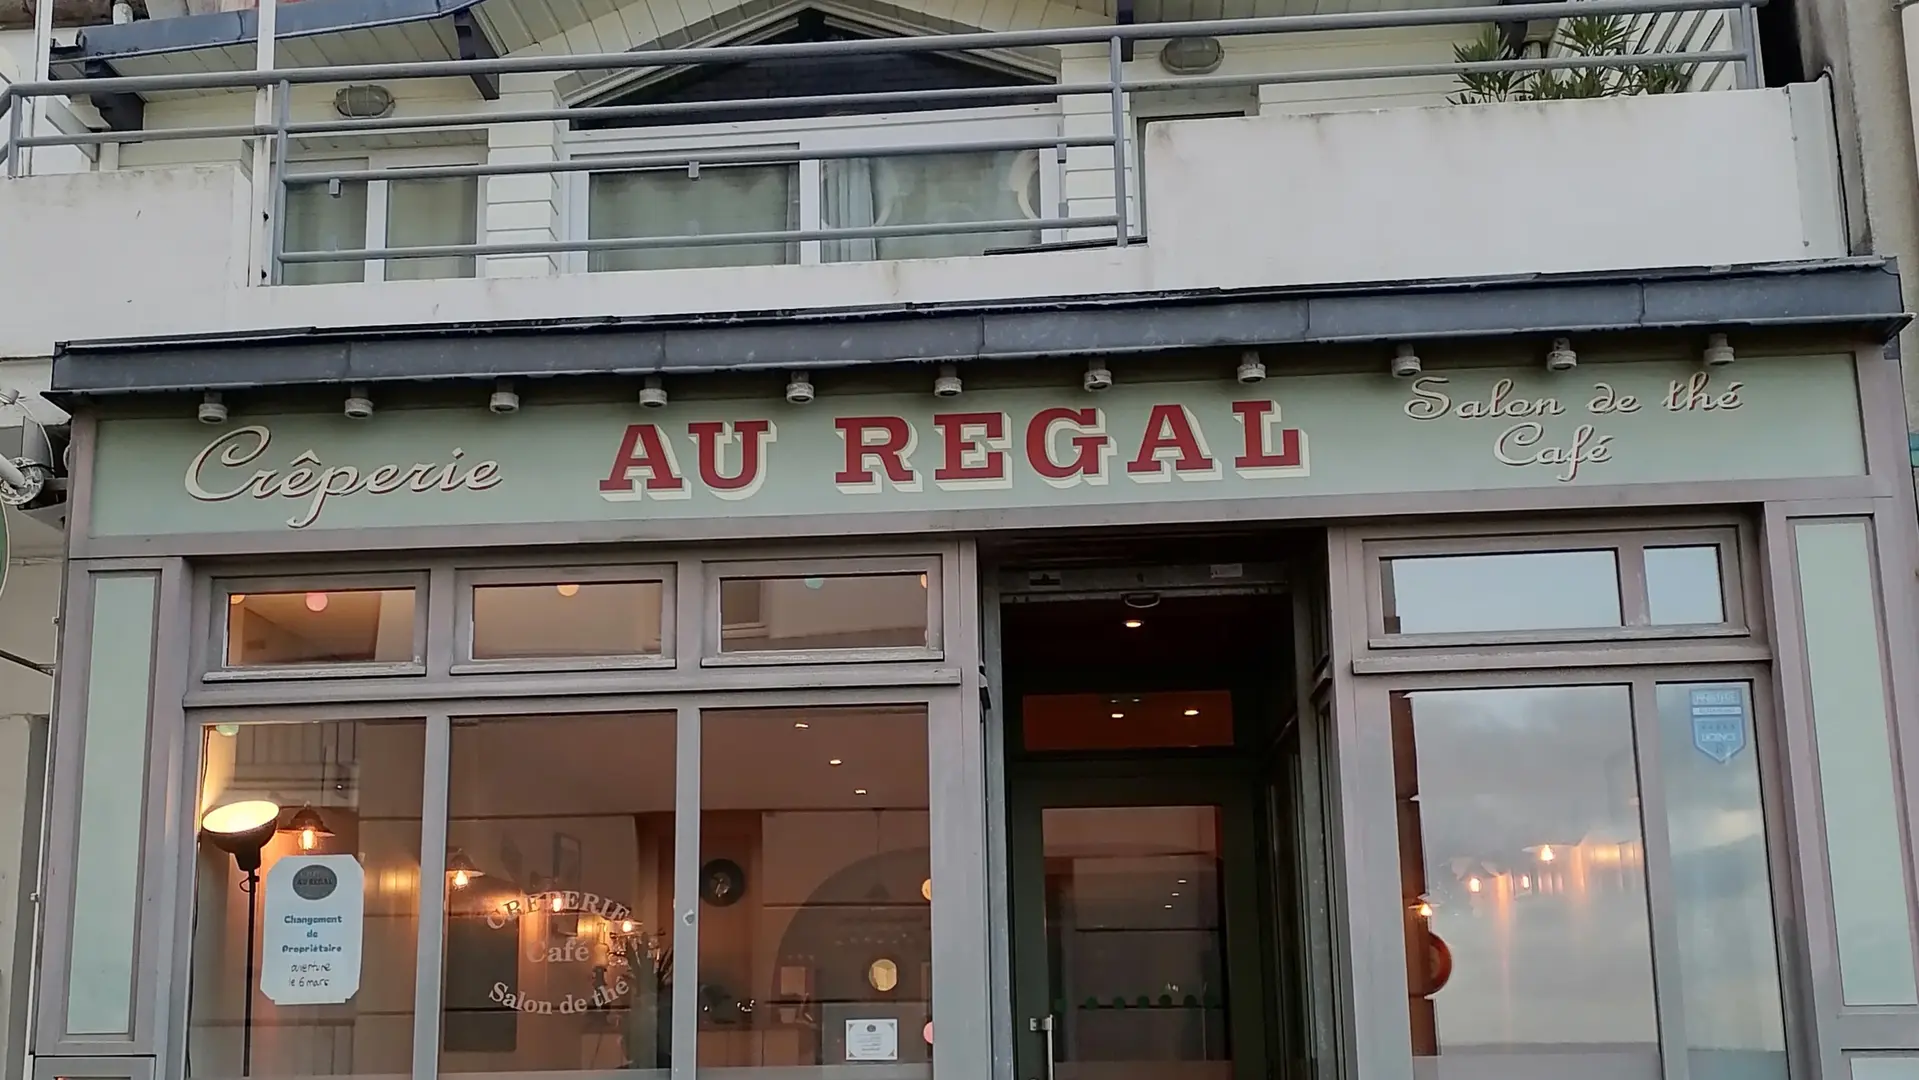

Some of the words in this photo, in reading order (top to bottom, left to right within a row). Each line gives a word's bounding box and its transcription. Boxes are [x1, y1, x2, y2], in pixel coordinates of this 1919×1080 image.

[1403, 376, 1566, 420] Salon
[1585, 383, 1642, 414] de
[1661, 371, 1744, 412] thé
[599, 419, 778, 501] AU
[834, 400, 1311, 494] REGAL
[1493, 421, 1614, 481] Café
[184, 425, 503, 528] Crêperie
[284, 915, 342, 925] Changement
[306, 929, 318, 938] de
[282, 944, 342, 953] Propriétaire
[526, 939, 589, 963] Café
[299, 977, 304, 987] 6
[489, 982, 552, 1014] Salon
[560, 994, 587, 1014] de
